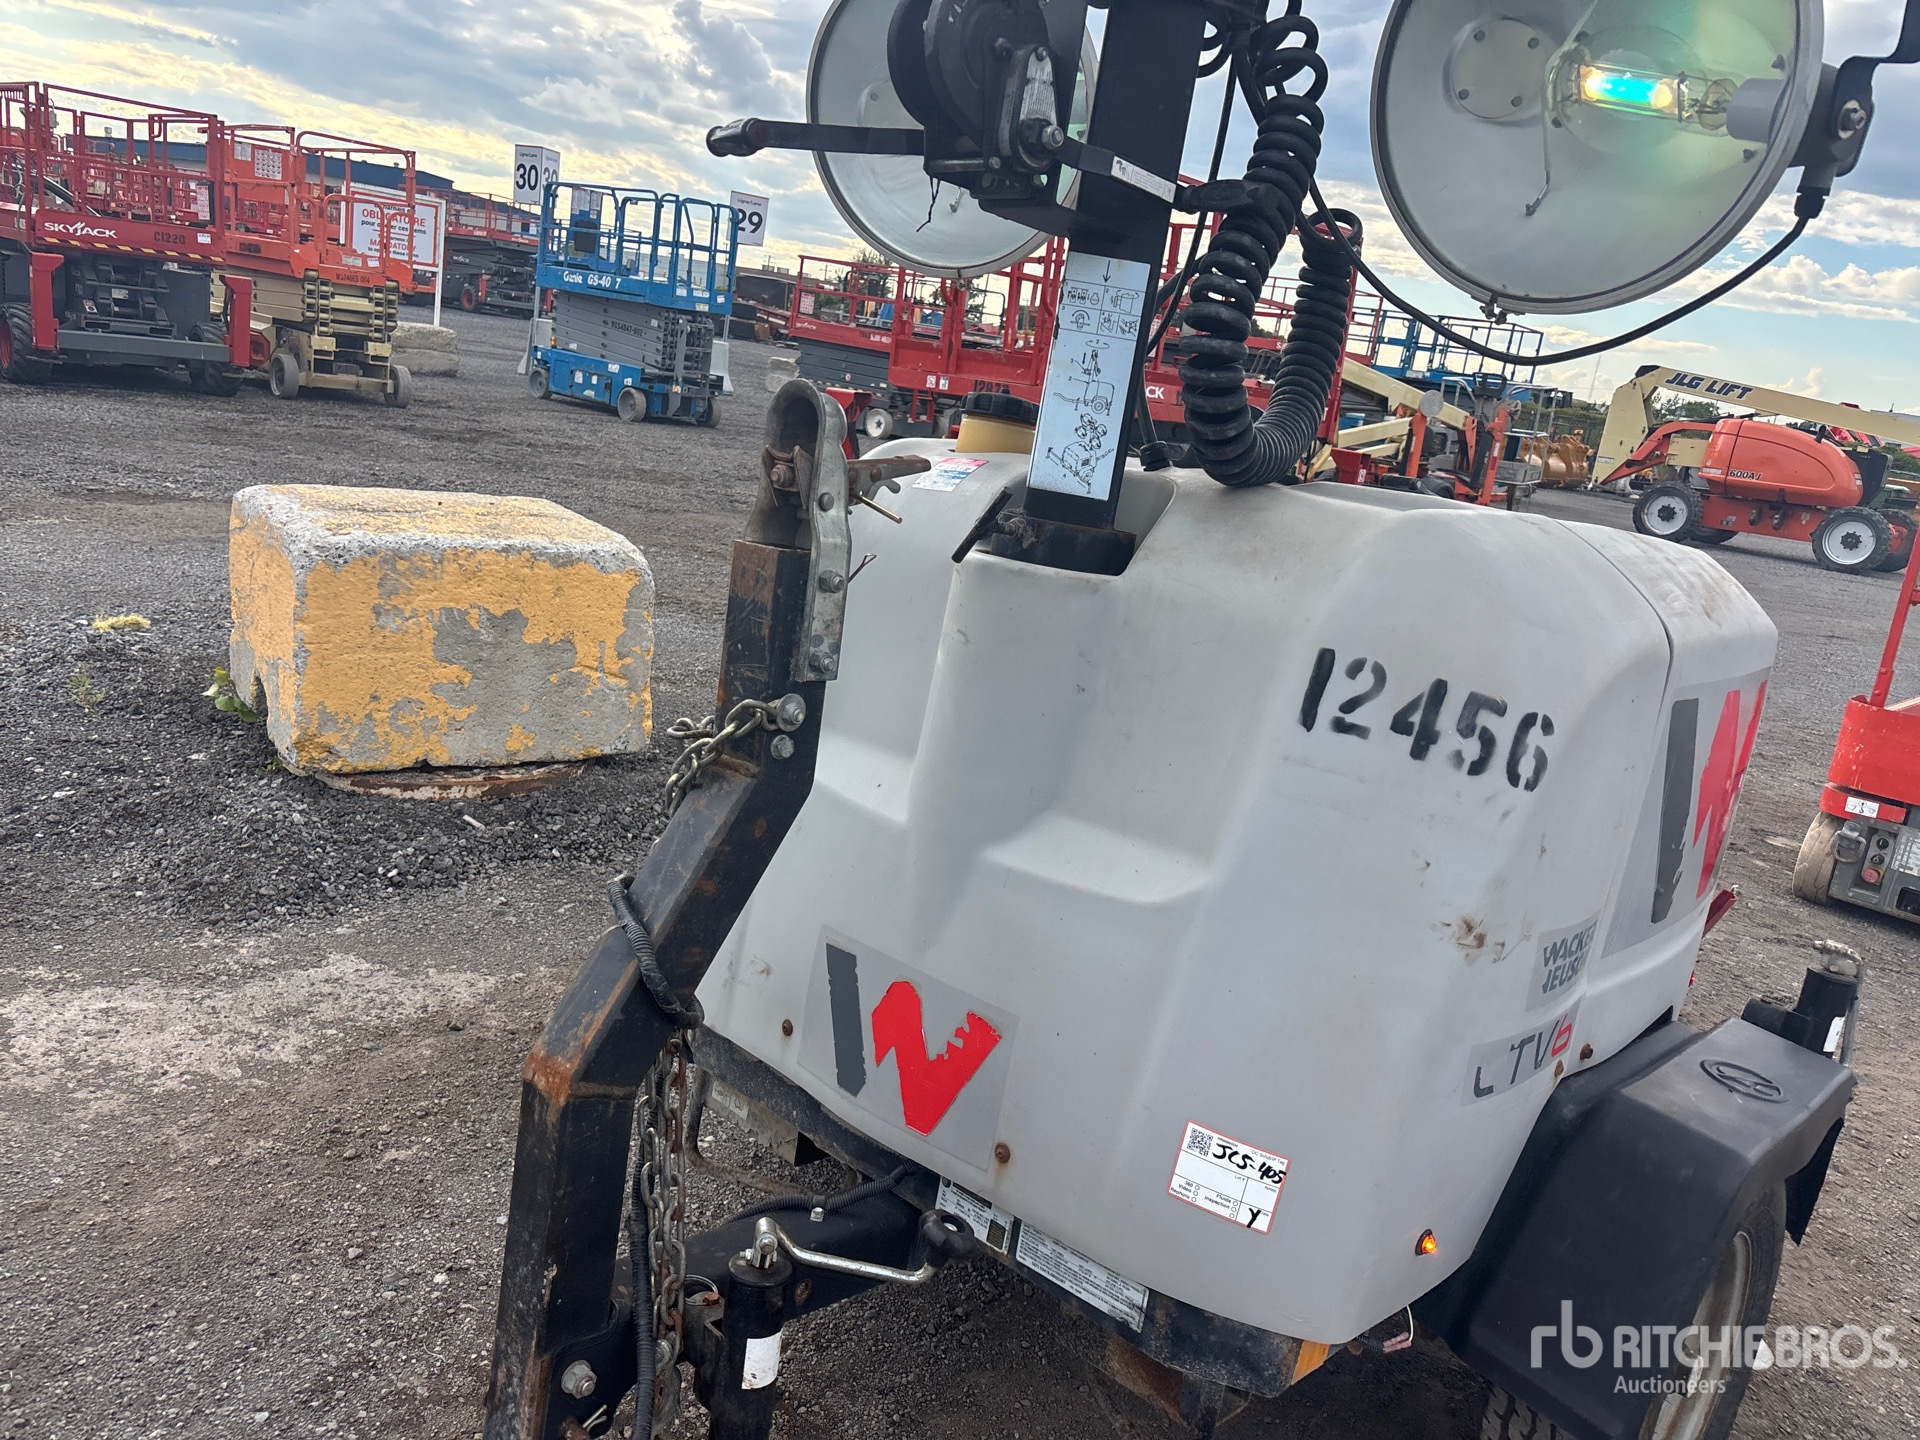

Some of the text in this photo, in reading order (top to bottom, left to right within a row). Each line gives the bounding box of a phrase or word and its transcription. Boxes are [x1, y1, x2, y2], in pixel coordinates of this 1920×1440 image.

[516, 163, 539, 191] 30
[542, 167, 559, 187] 30
[361, 219, 376, 227] pour
[362, 208, 426, 228] OBLGATORE
[44, 221, 117, 239] SKYJACK
[154, 231, 185, 245] C1220
[369, 238, 416, 252] MADATOY
[1665, 372, 1754, 400] JLG LIFT
[1729, 469, 1762, 481] 600AJ
[1298, 647, 1555, 792] 12456
[1178, 1183, 1192, 1193] Video
